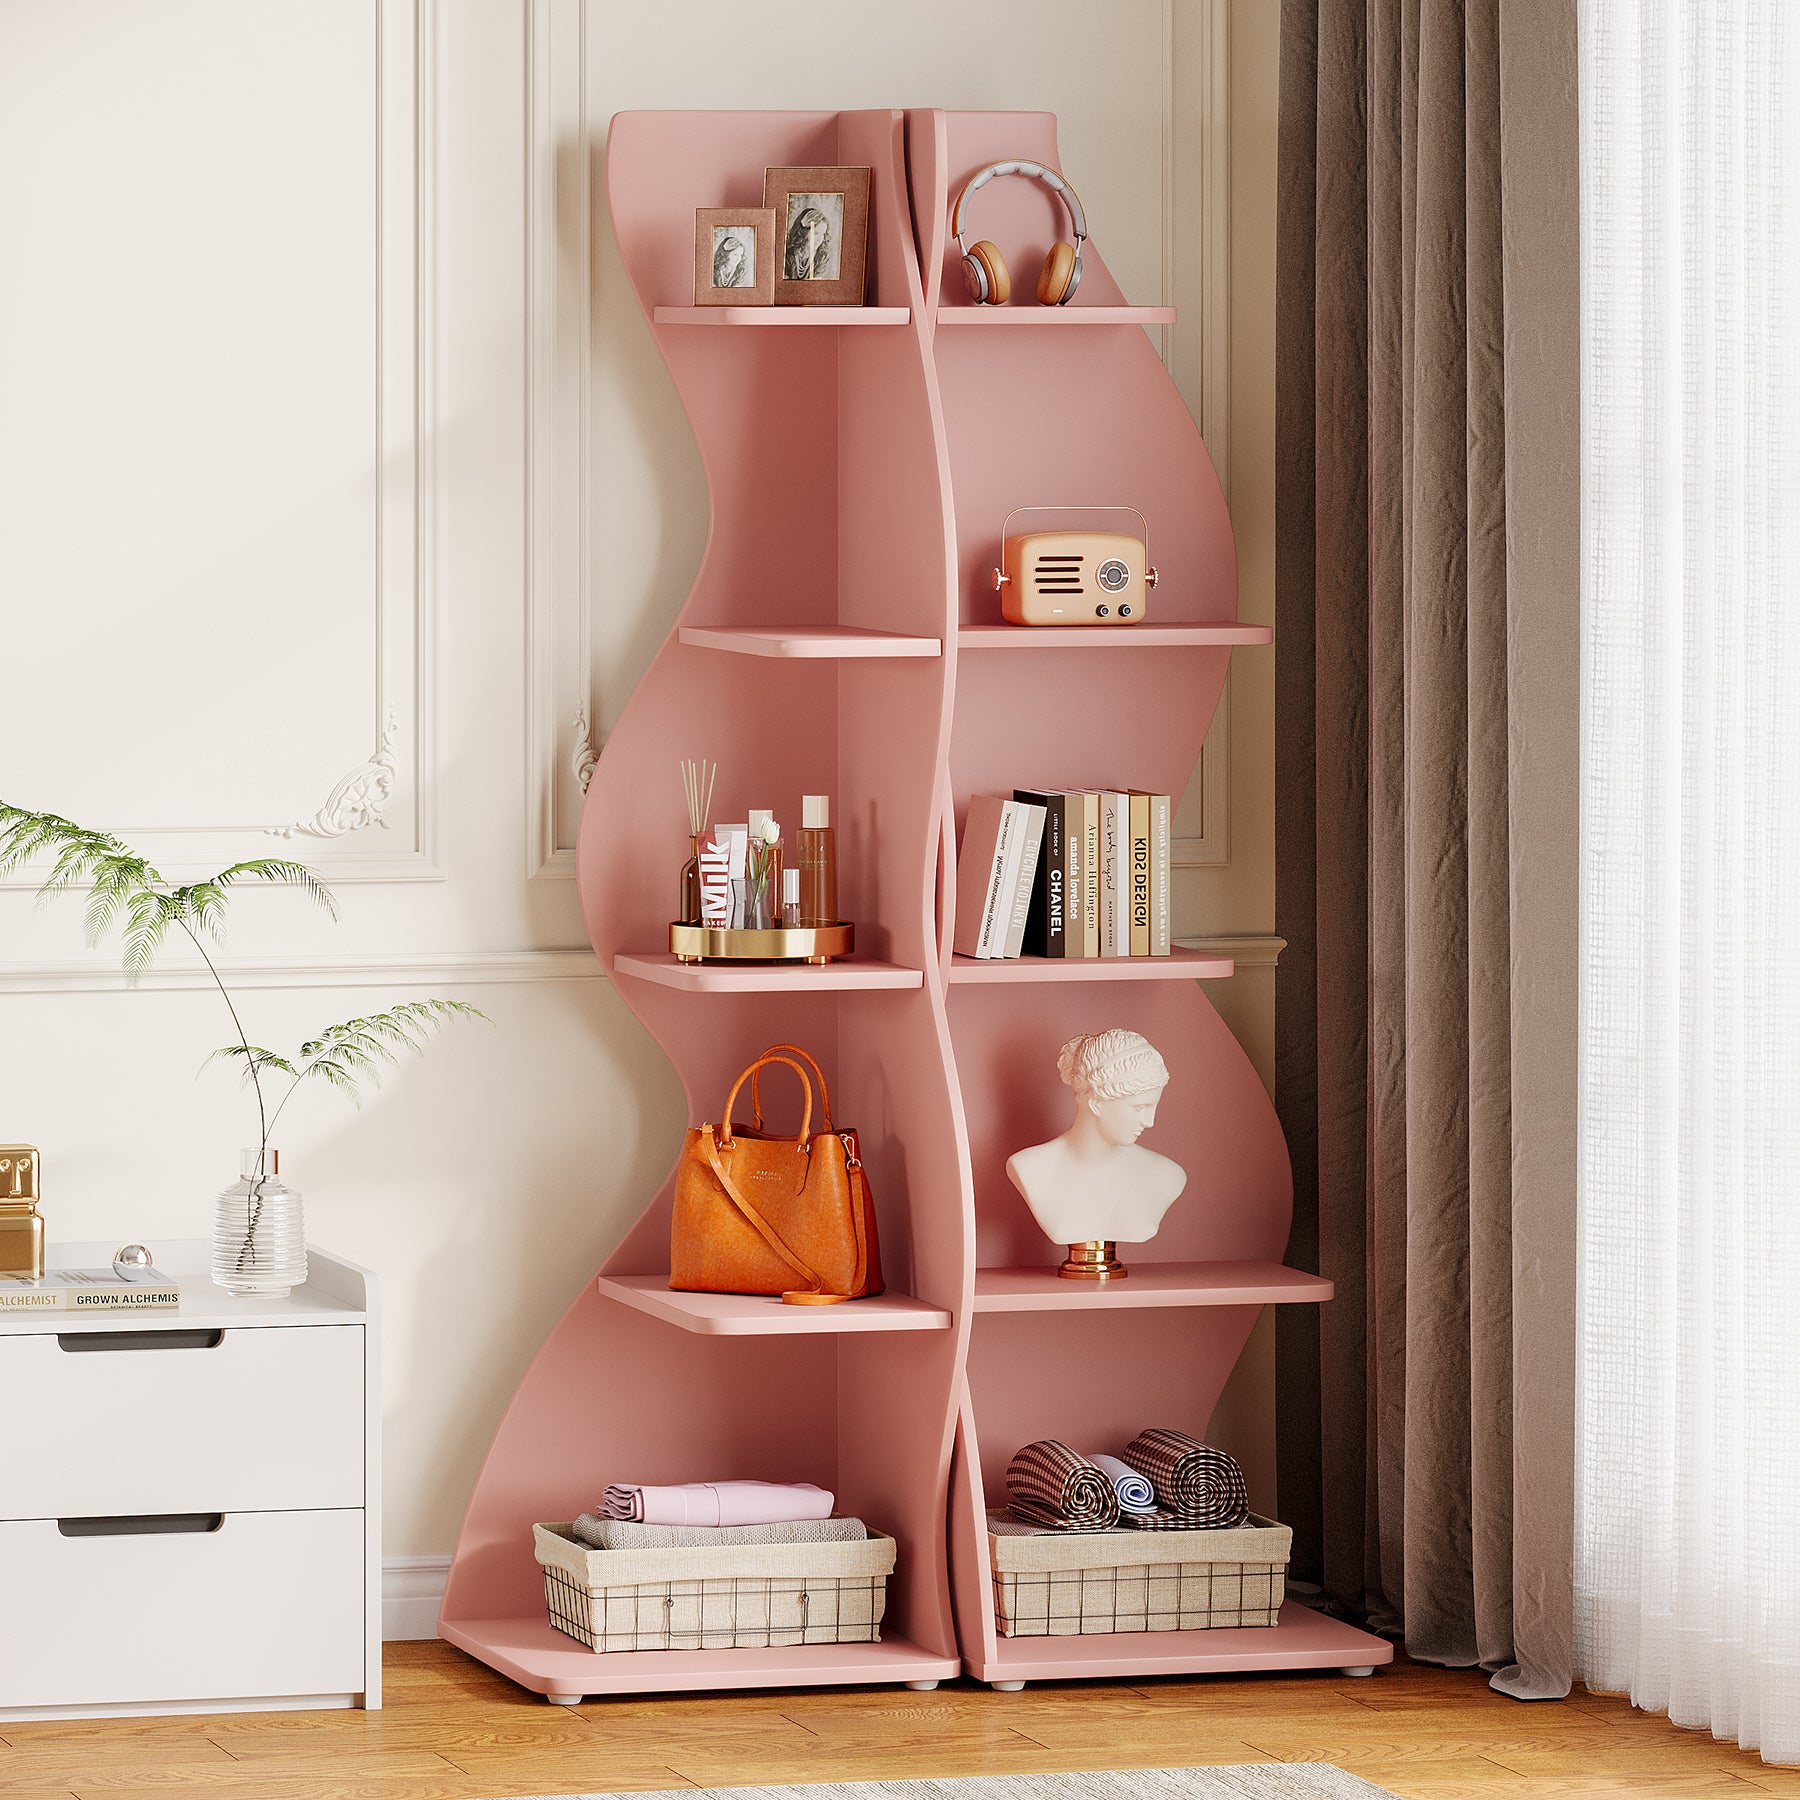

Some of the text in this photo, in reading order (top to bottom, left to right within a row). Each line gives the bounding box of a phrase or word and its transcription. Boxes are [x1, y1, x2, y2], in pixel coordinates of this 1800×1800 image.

[1106, 808, 1115, 829] The
[1053, 848, 1059, 856] OF
[1085, 824, 1097, 929] Arianna Huffington
[1102, 857, 1115, 890] beyond
[701, 841, 731, 918] Milk
[1050, 869, 1062, 937] CHANEL
[1070, 836, 1080, 920] amanda lovelace
[76, 1293, 180, 1305] GROWN ALCHEMIS
